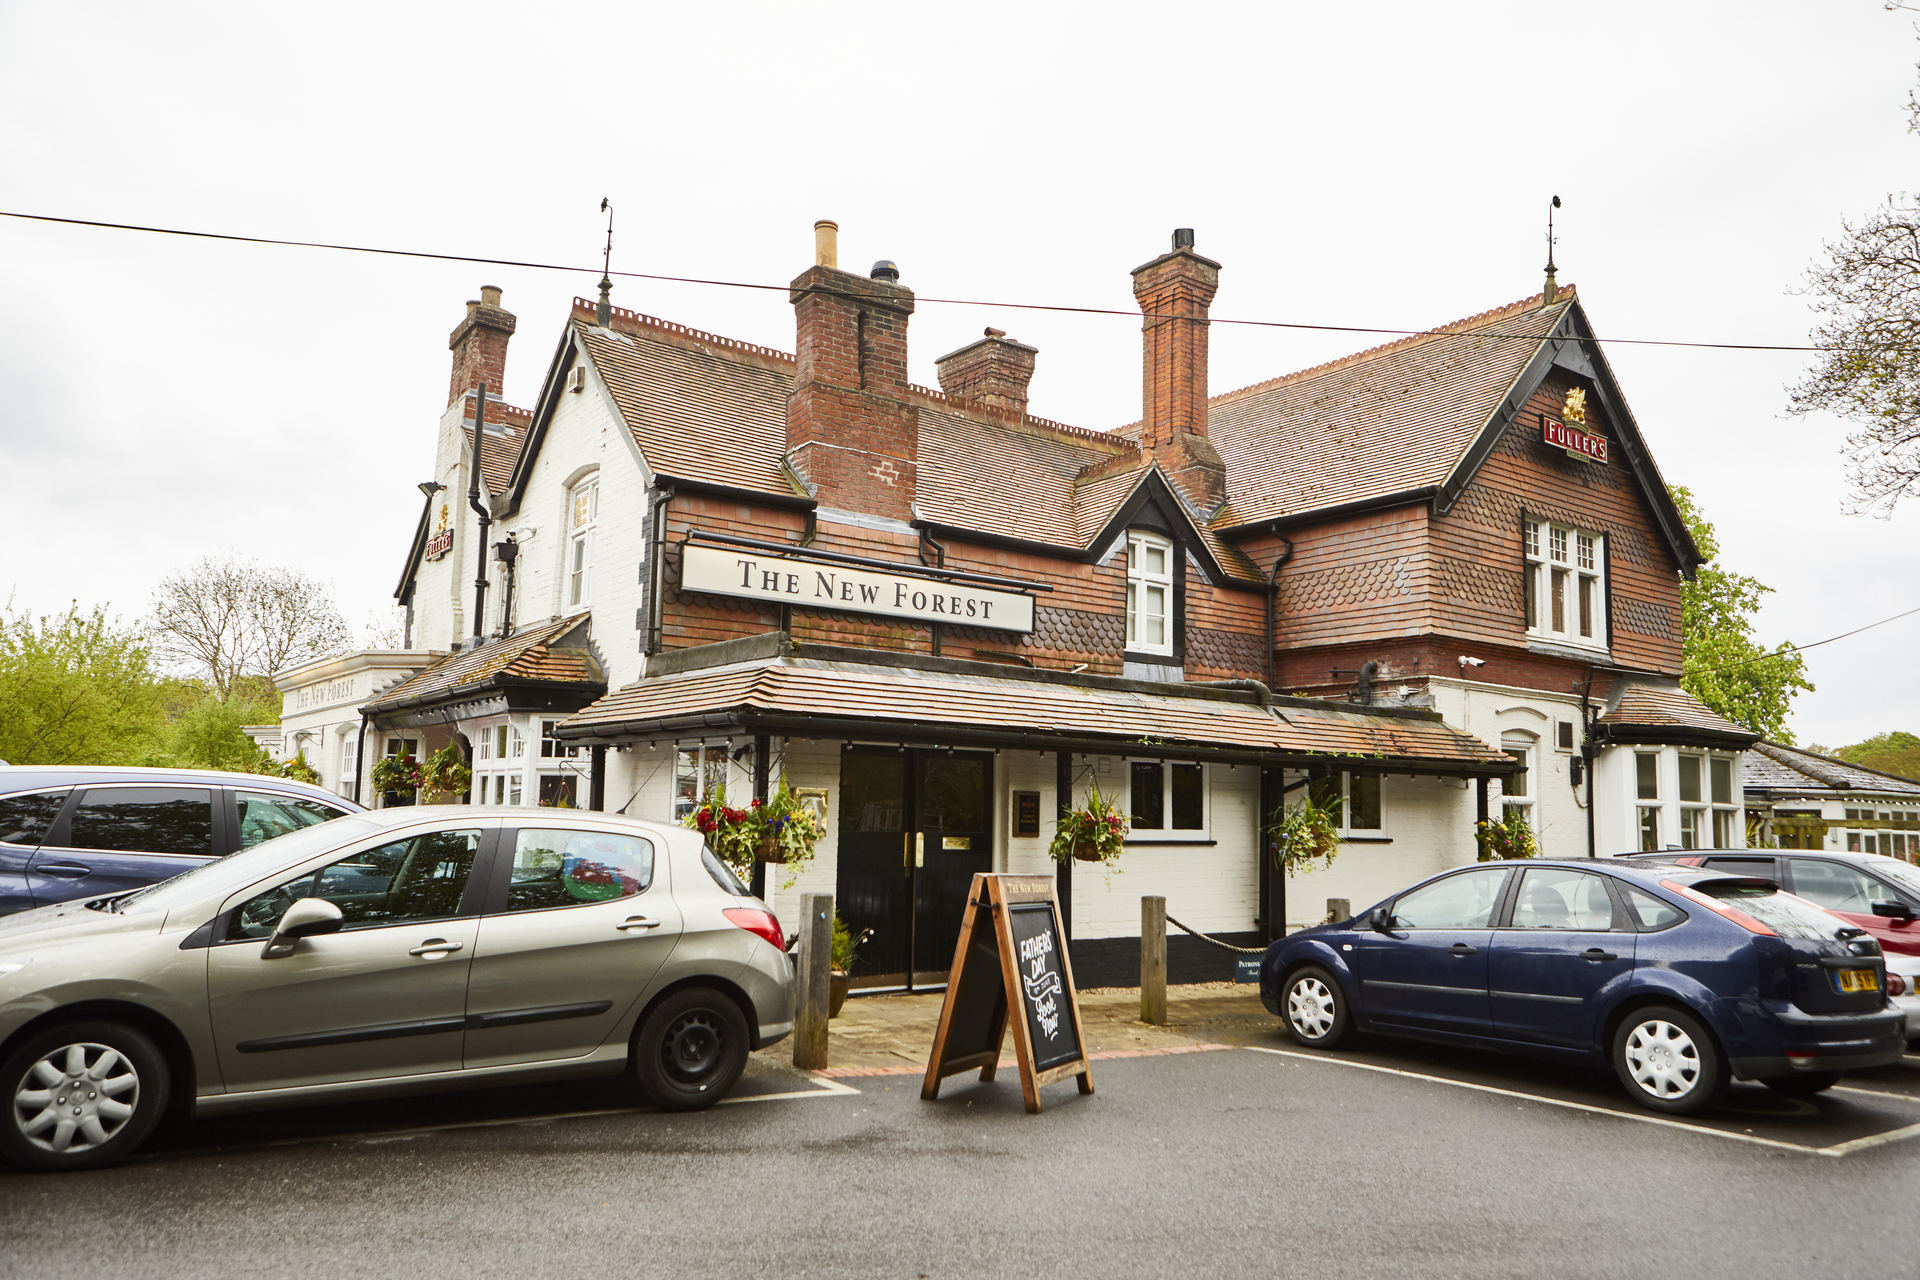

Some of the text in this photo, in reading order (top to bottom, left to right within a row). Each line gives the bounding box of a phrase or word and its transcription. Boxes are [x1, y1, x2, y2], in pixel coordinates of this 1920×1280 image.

[1548, 421, 1606, 458] FULLER'S
[737, 560, 993, 619] THE NEW FOREST
[327, 679, 354, 701] FOREST
[1020, 928, 1052, 963] FATHER'S
[1031, 954, 1046, 980] DAY
